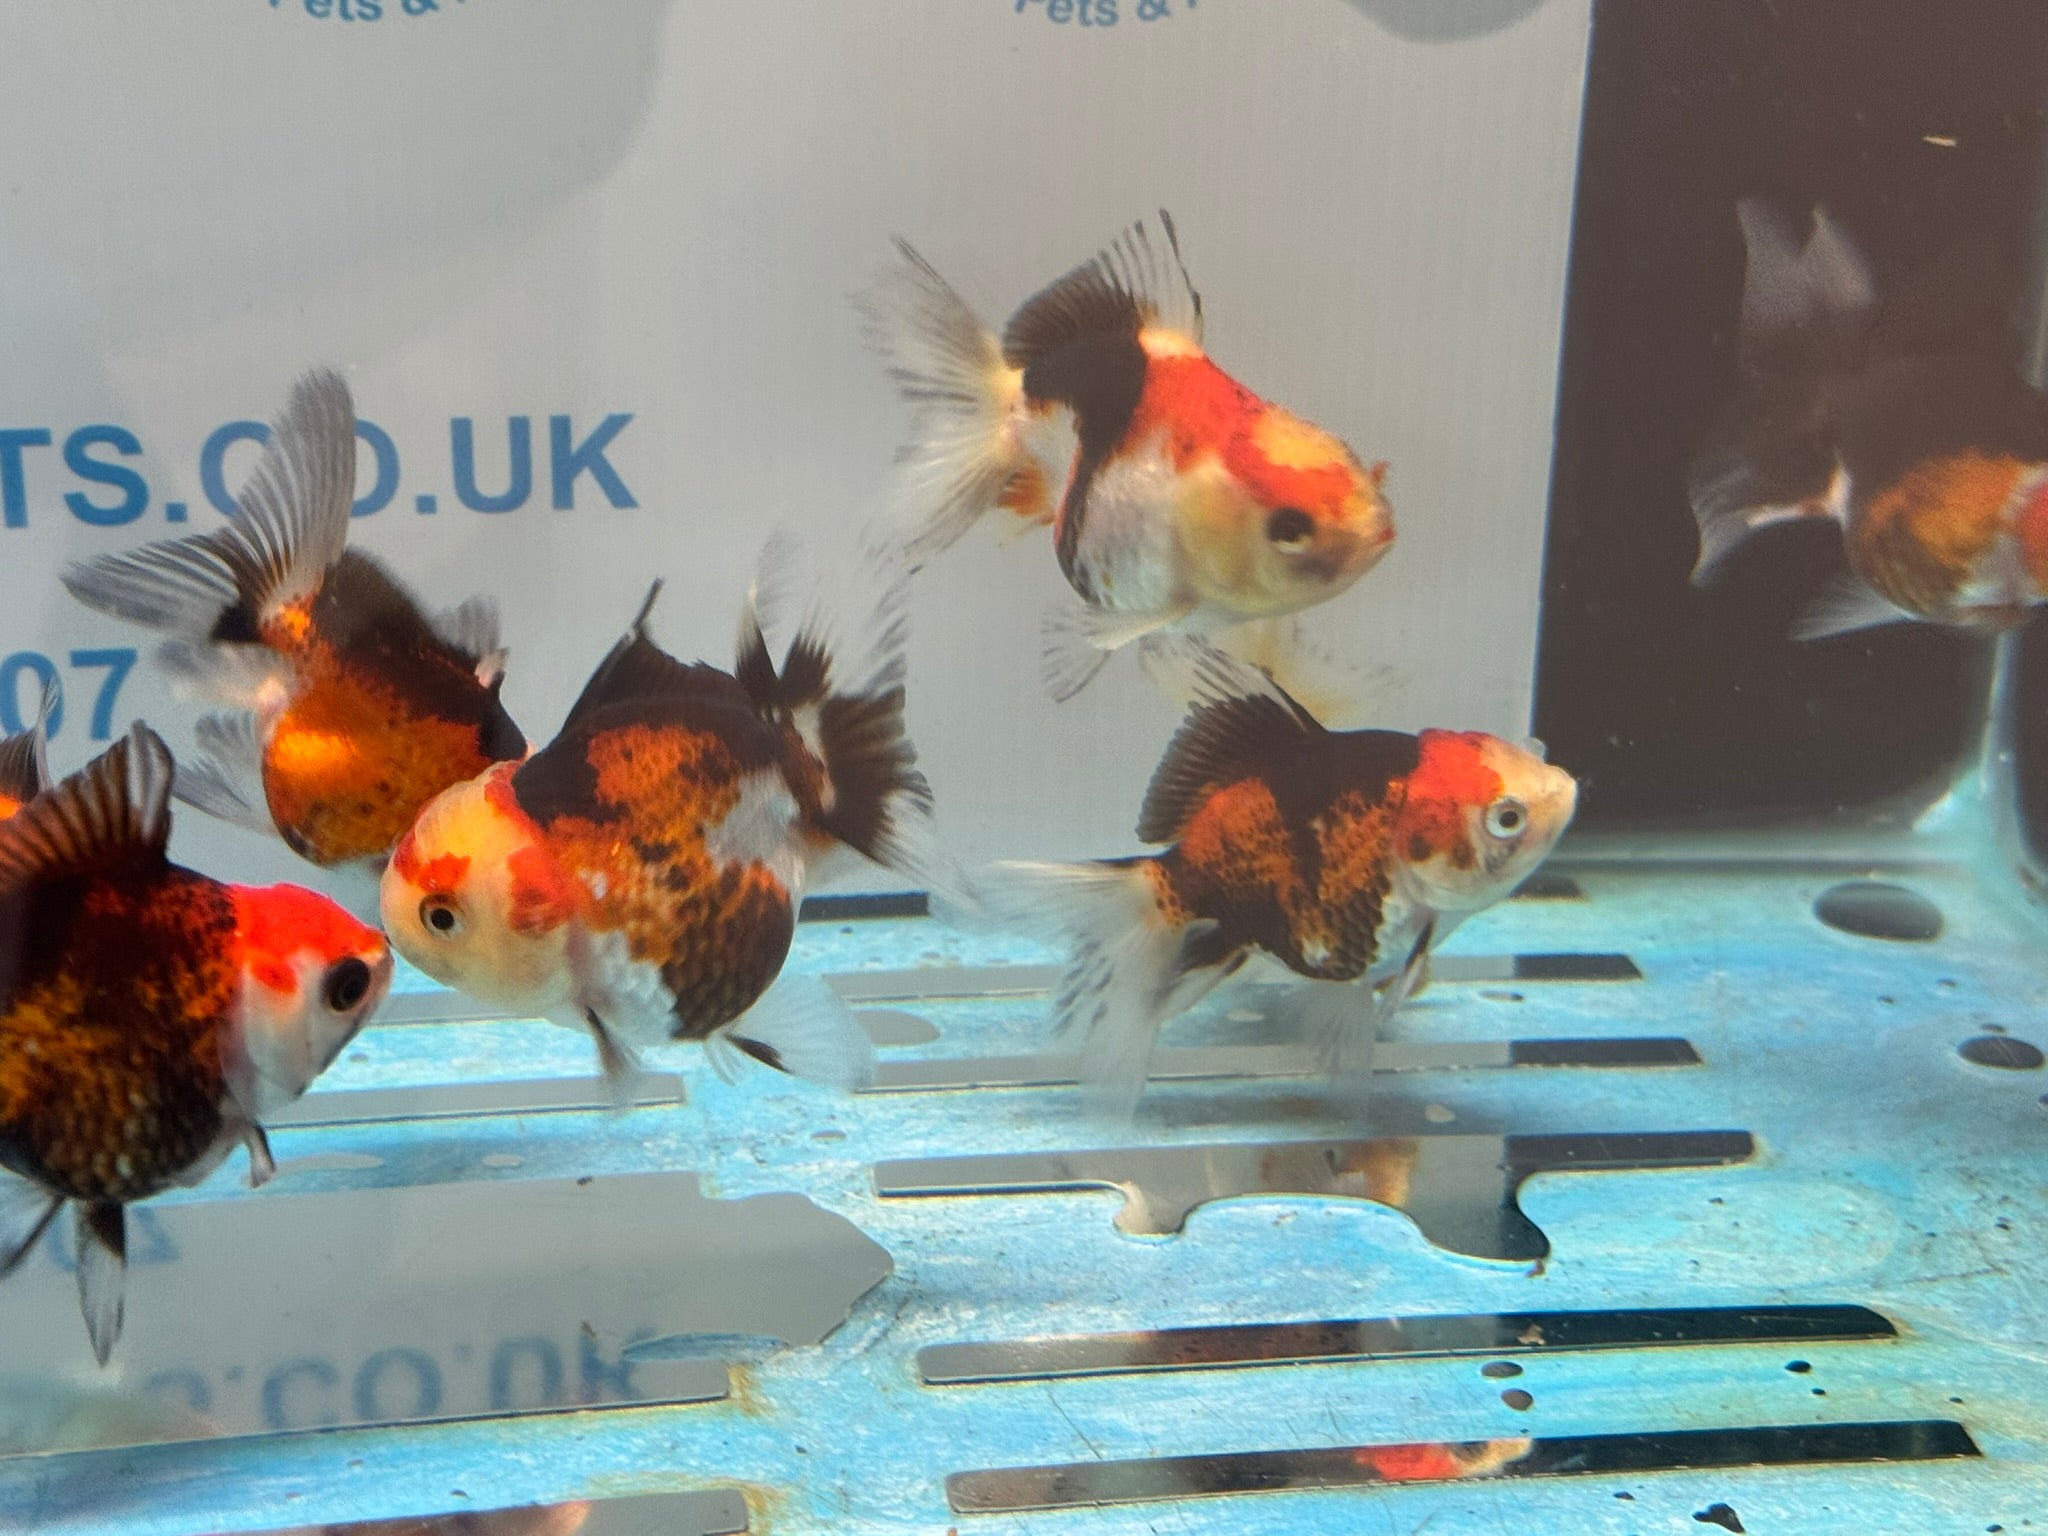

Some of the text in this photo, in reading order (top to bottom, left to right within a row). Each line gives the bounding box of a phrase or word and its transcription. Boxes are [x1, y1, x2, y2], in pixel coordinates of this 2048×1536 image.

[269, 0, 383, 22] ets
[1136, 0, 1172, 22] &
[0, 648, 138, 741] 07
